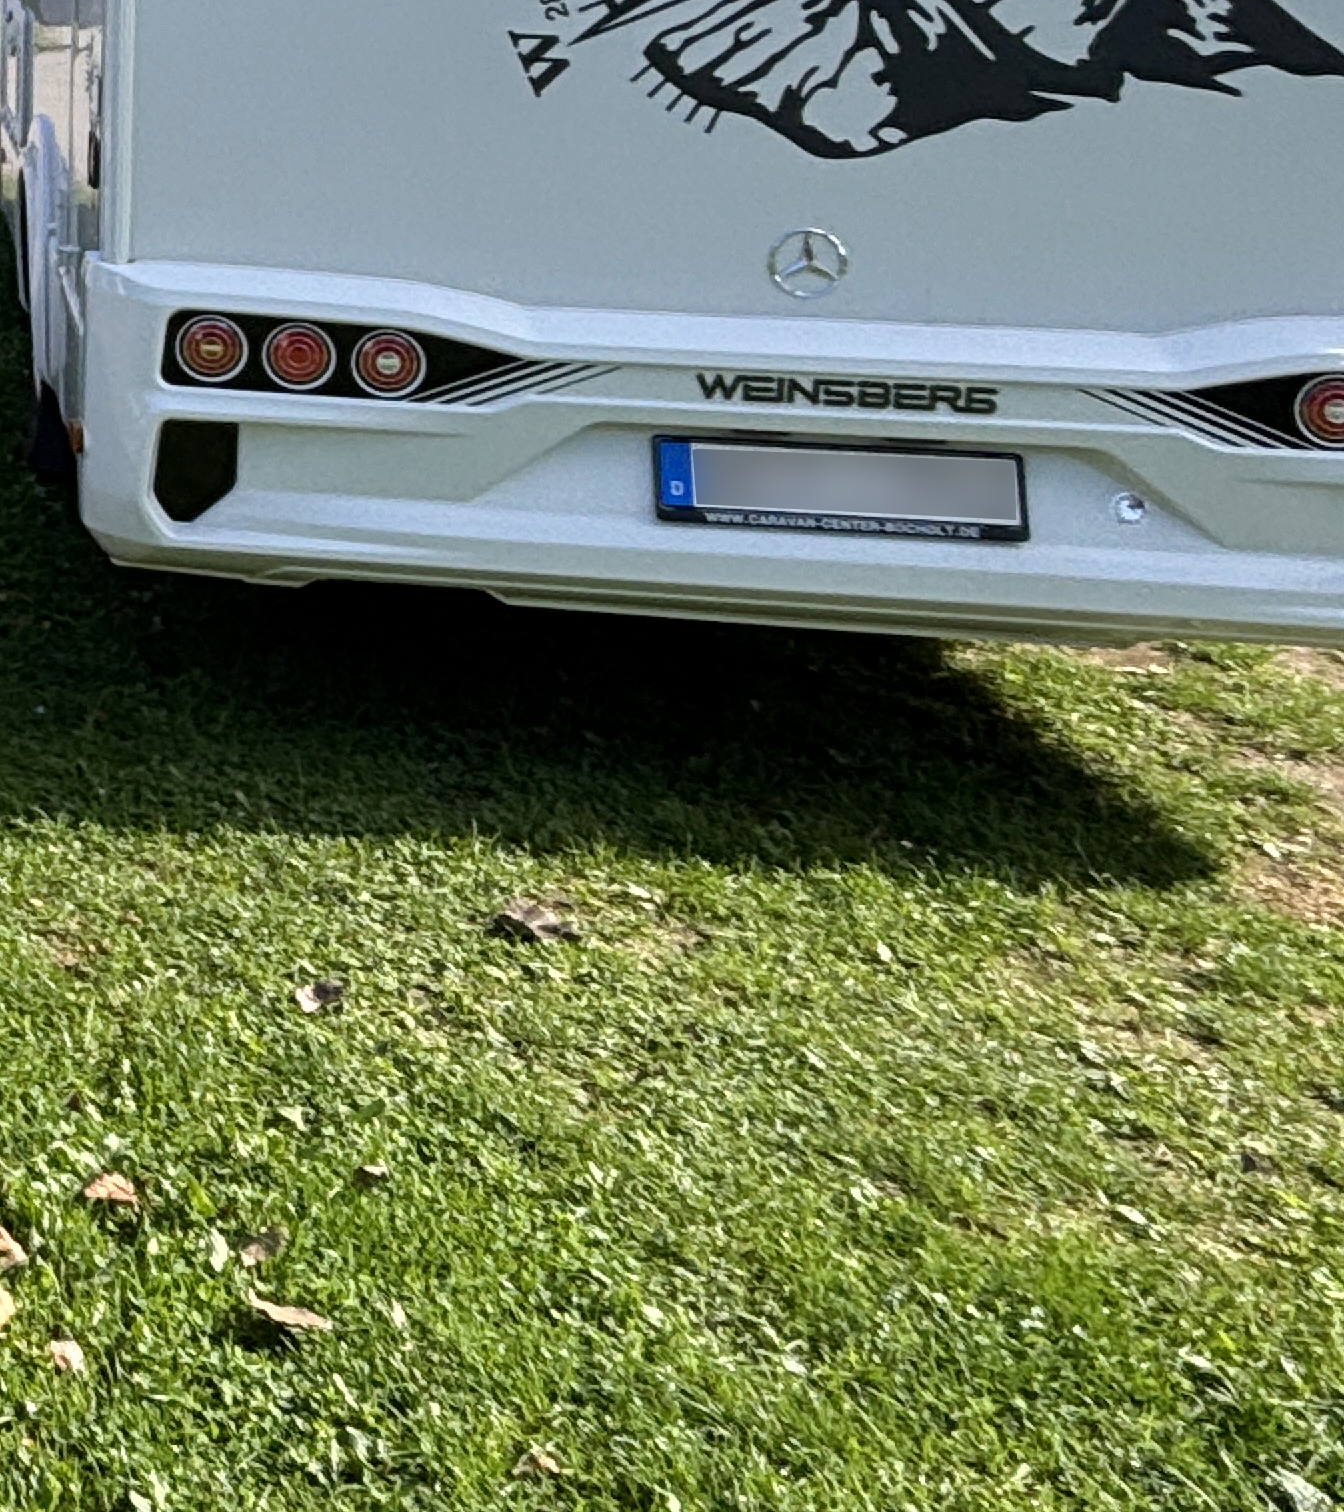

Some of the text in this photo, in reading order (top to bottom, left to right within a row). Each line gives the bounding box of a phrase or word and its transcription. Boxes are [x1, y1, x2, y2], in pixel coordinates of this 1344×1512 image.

[508, 30, 570, 98] W
[696, 373, 999, 414] WEINSBERG
[670, 481, 684, 496] D
